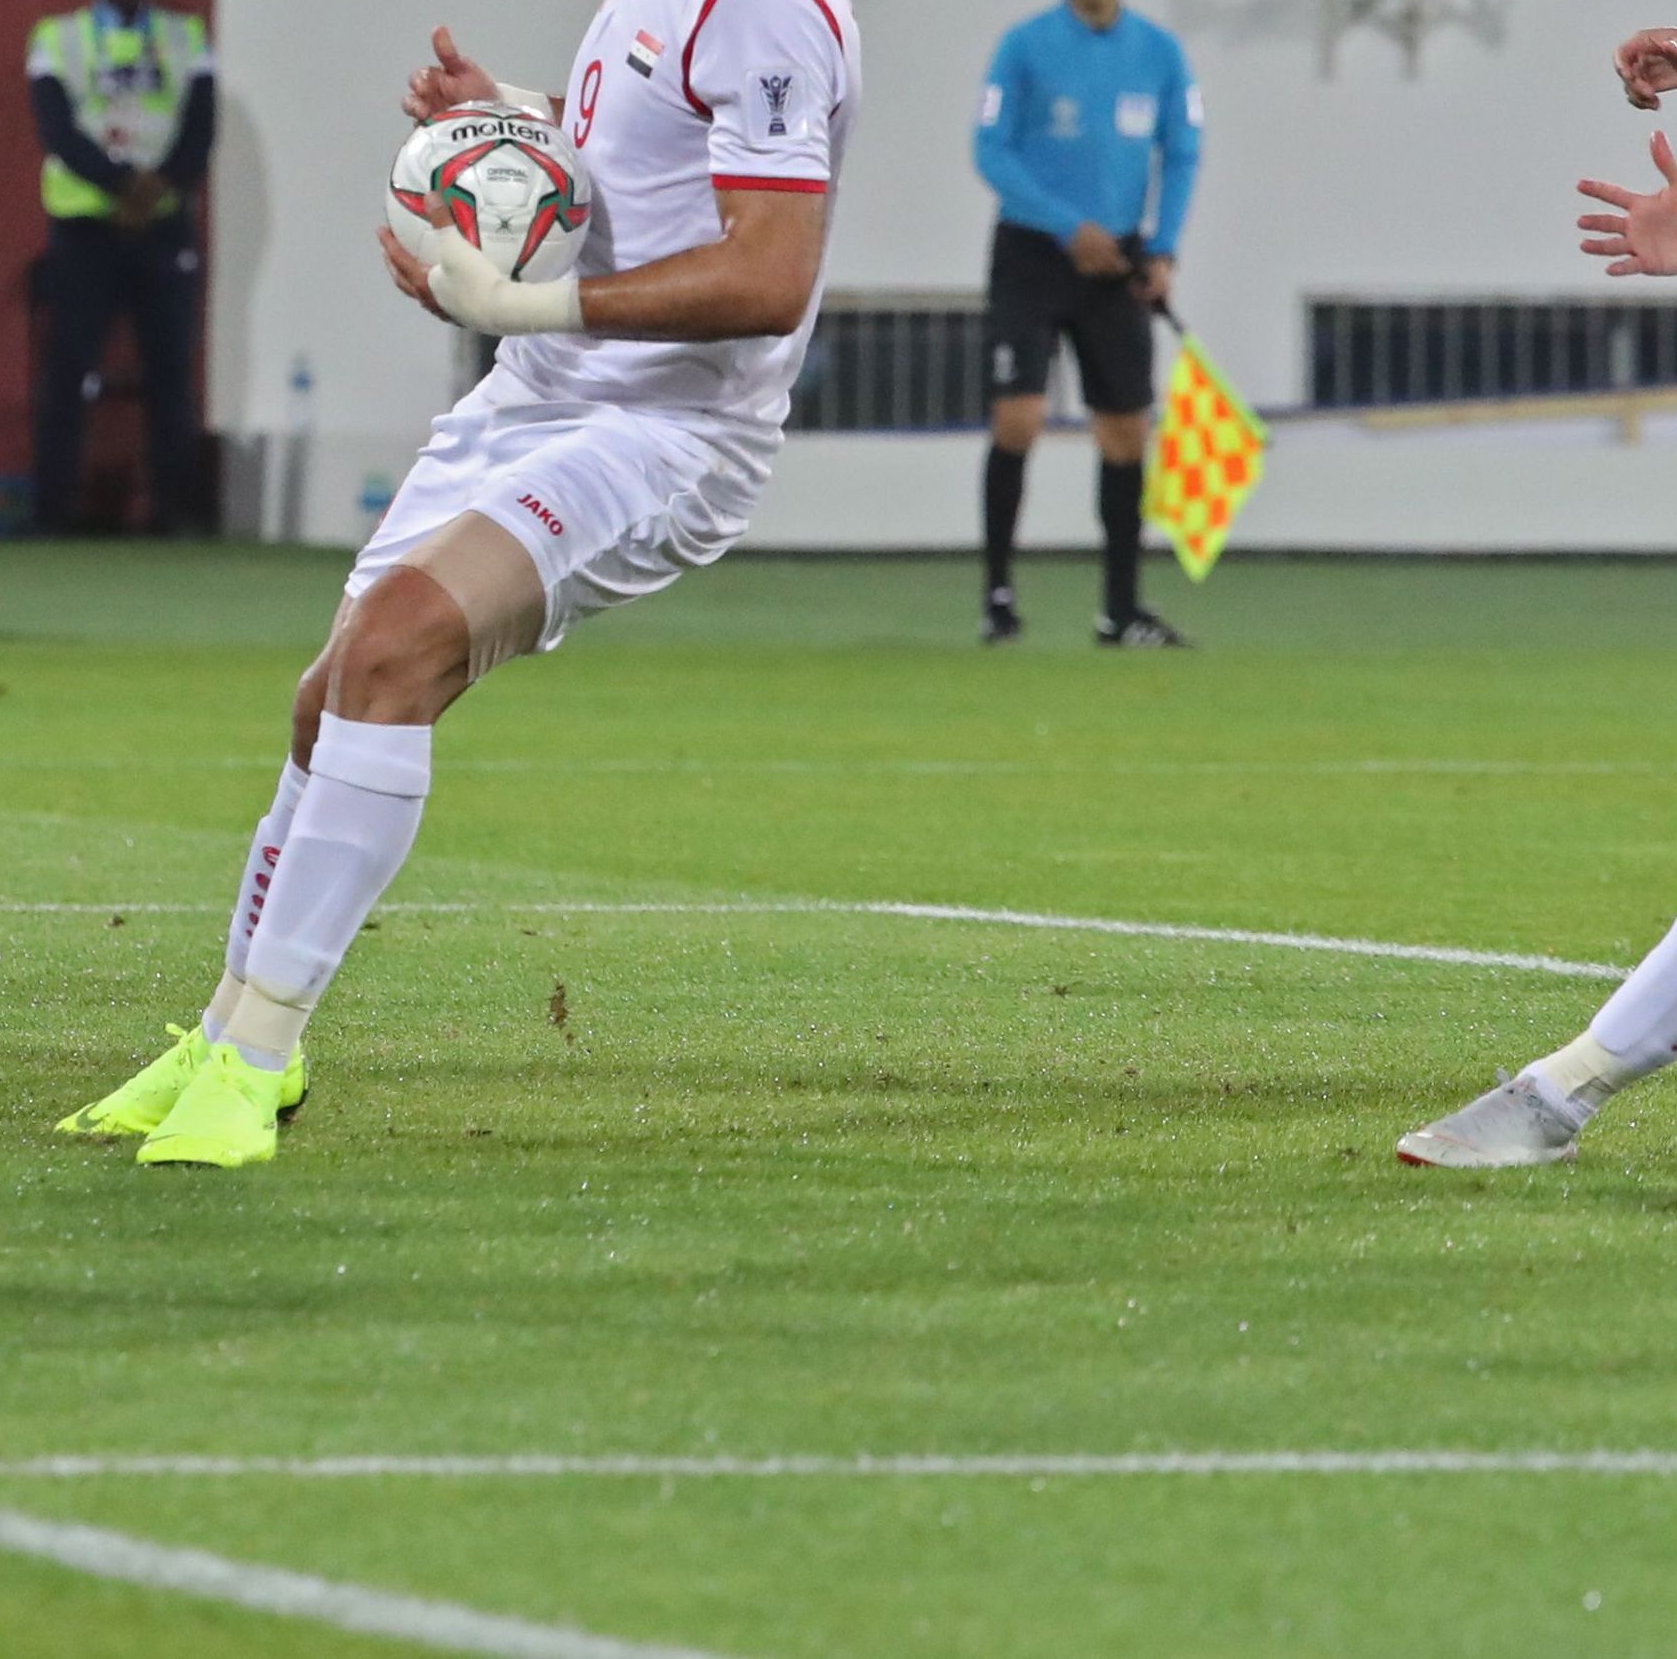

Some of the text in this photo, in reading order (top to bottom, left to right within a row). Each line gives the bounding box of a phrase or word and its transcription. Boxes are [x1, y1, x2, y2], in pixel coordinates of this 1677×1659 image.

[574, 59, 602, 149] 9
[451, 120, 550, 145] molten
[516, 493, 563, 536] JAKO
